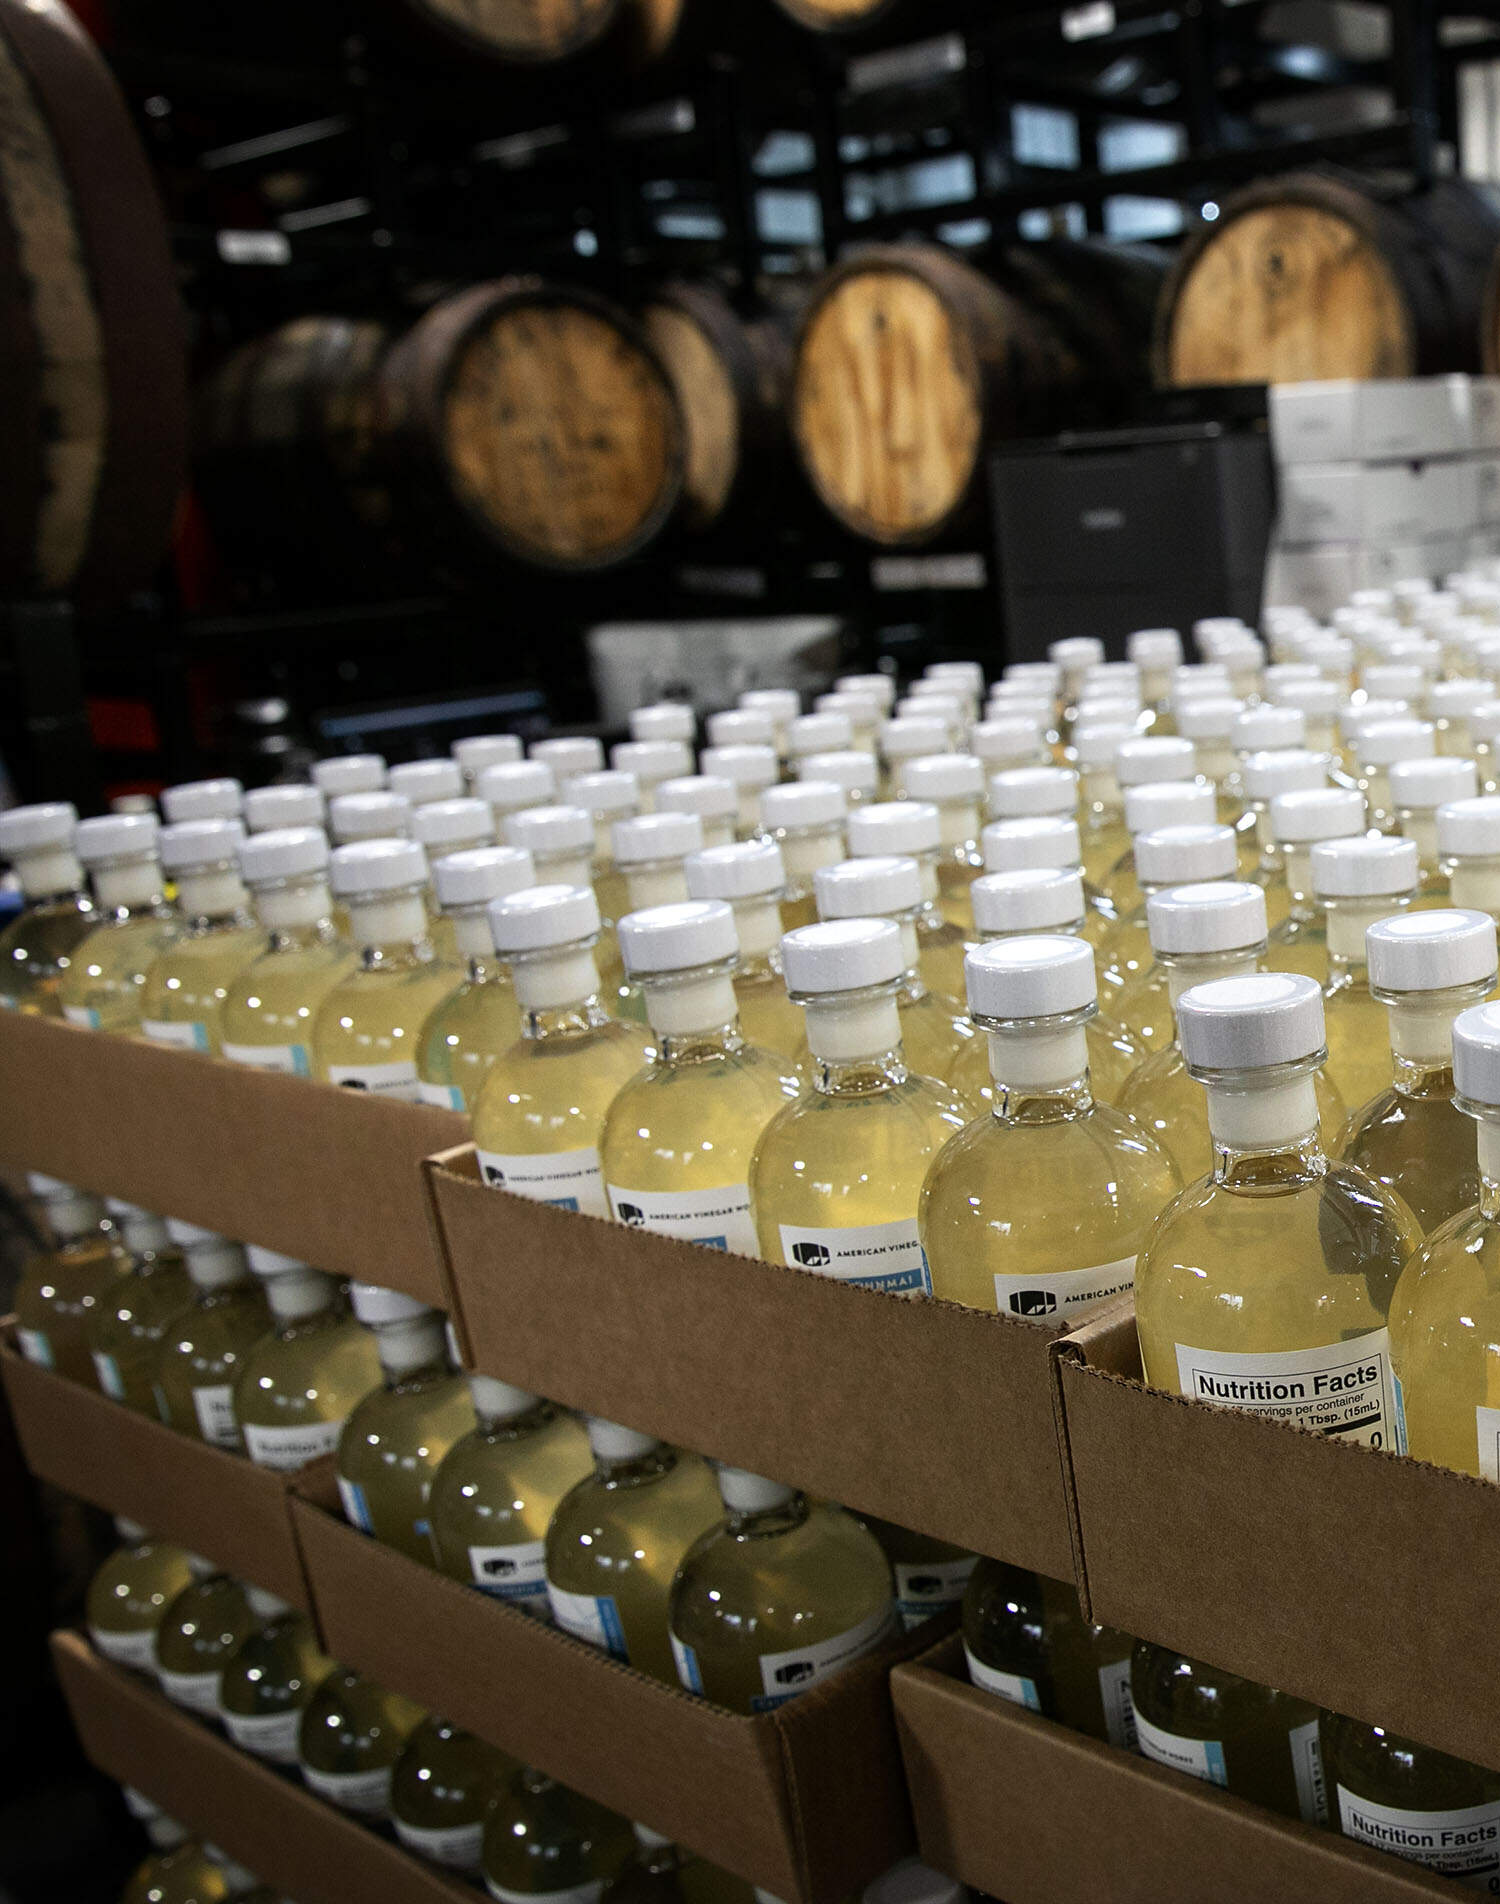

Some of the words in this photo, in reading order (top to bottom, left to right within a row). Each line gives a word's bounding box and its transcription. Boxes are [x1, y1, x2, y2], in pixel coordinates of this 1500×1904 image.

[836, 1246, 887, 1258] AMERICAN
[1064, 1287, 1117, 1304] AMERICAN
[1118, 1281, 1134, 1293] VIN
[1200, 1375, 1305, 1400] Nutrition
[1313, 1365, 1378, 1395] Facts
[1295, 1405, 1313, 1417] per
[1317, 1392, 1365, 1411] container
[1309, 1412, 1341, 1426] Tbsp.
[1344, 1399, 1380, 1420] (15mL)
[1352, 1812, 1435, 1848] Nutrition
[1440, 1825, 1498, 1847] Facts
[1443, 1846, 1485, 1859] container
